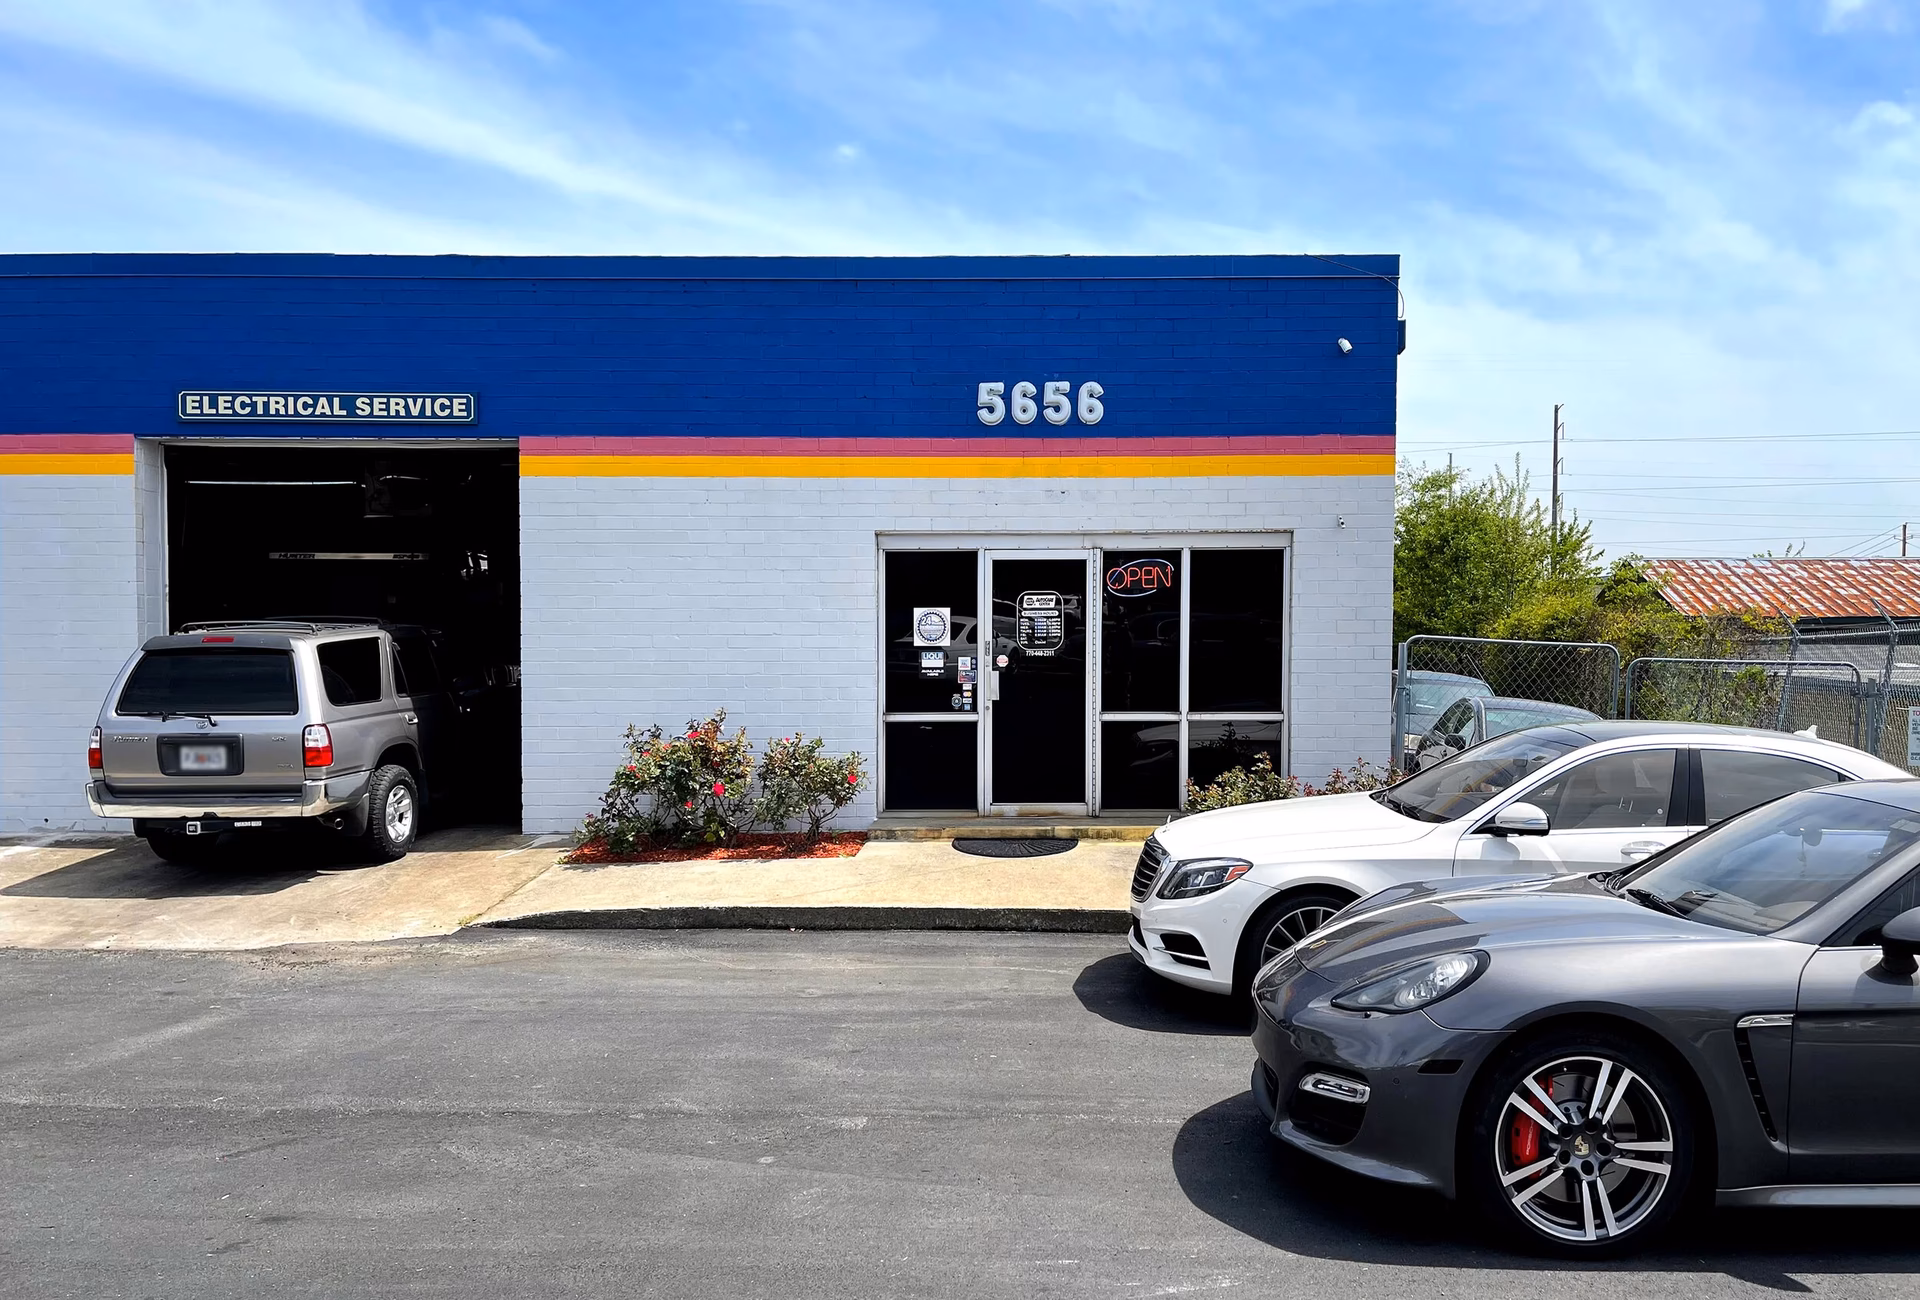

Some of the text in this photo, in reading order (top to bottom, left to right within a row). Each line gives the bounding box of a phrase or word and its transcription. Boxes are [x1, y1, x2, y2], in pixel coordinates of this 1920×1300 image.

[186, 396, 468, 417] ELECTRICAL SERVICE
[977, 381, 1105, 426] 5656
[1107, 566, 1172, 589] OPEN
